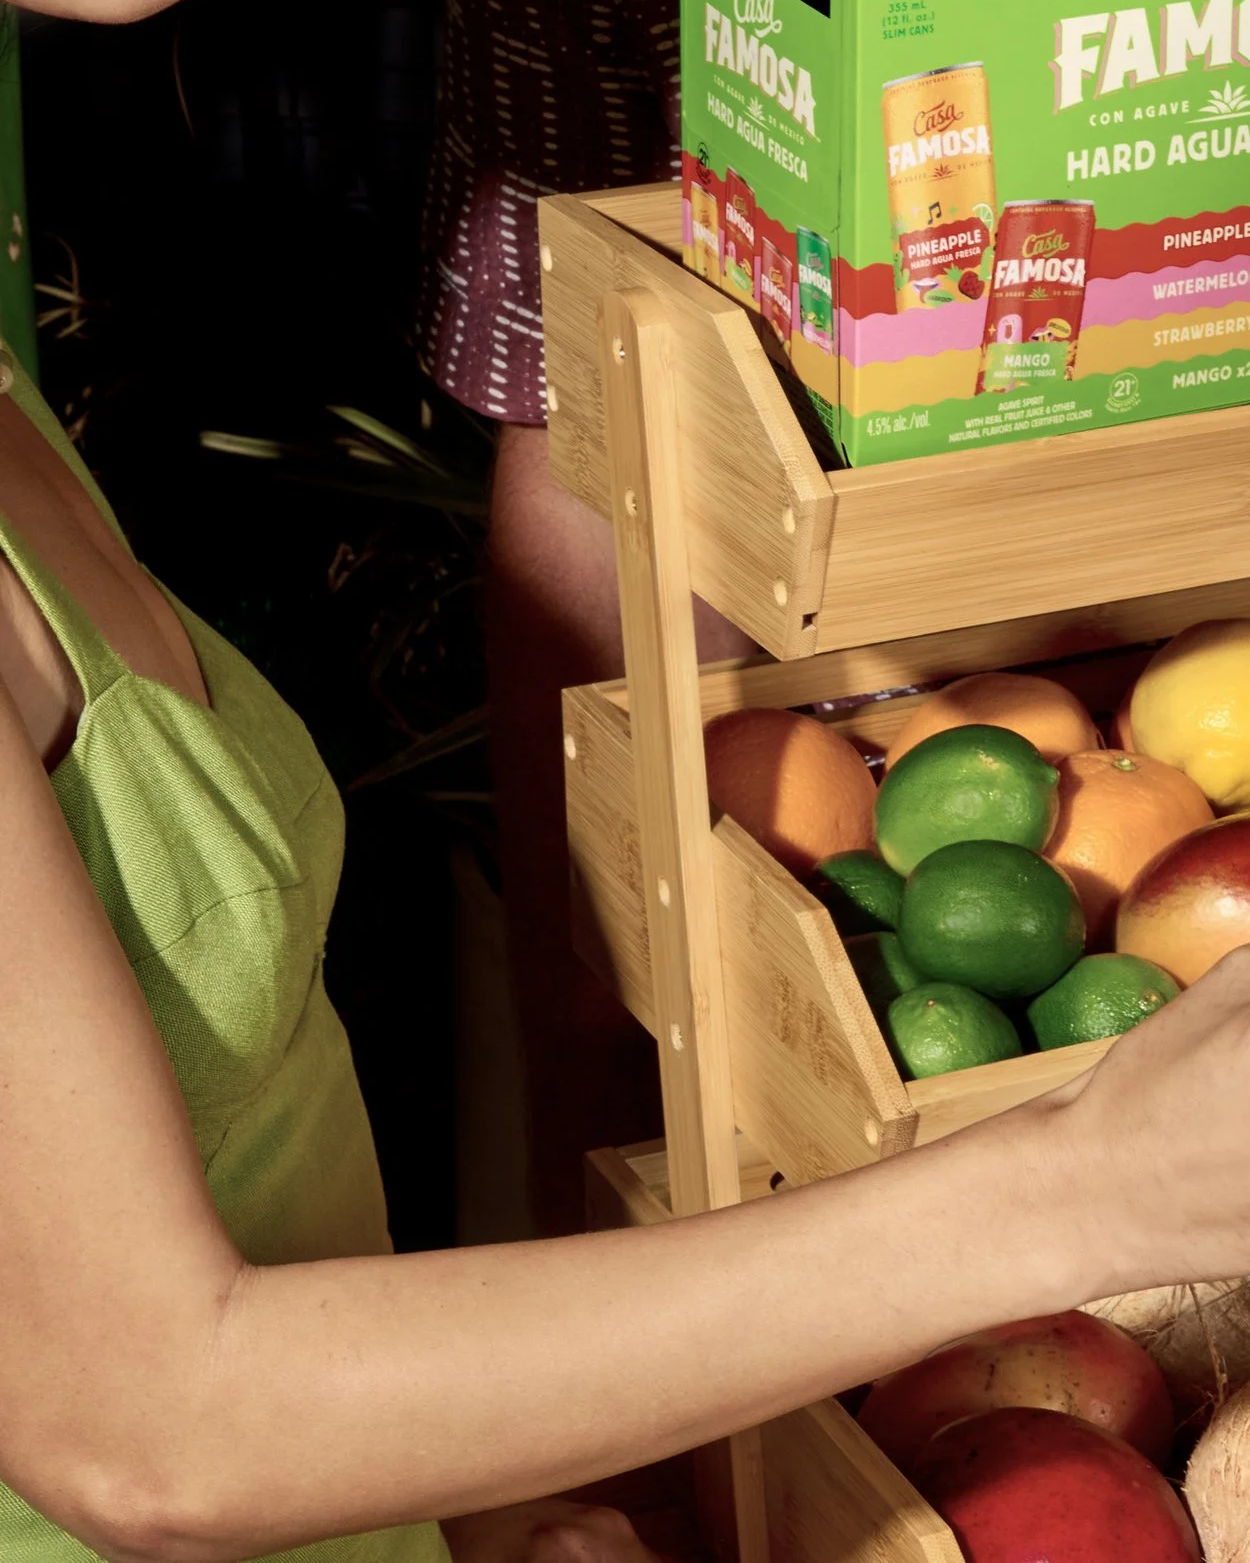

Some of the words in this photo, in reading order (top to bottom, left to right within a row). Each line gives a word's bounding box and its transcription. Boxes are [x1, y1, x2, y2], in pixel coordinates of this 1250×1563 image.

[888, 1, 908, 13] 355
[911, 0, 926, 10] mL
[883, 28, 906, 39] SLIM
[909, 24, 934, 36] CANS
[704, 1, 816, 136] FAMOSA
[914, 100, 964, 137] Casa
[1089, 110, 1124, 127] CON
[1133, 100, 1190, 121] AGAVE
[707, 91, 734, 130] HARD
[736, 115, 765, 154] AGUA
[768, 138, 808, 182] FRESCA
[888, 124, 992, 178] FAMOSA
[1066, 140, 1156, 181] HARD
[726, 201, 755, 245] FAMOSA
[907, 229, 982, 259] PINEAPPLE
[932, 254, 954, 266] AGUA
[955, 246, 981, 261] FRESCA
[1022, 229, 1070, 258] Casa
[799, 264, 833, 299] FAMOSA
[993, 258, 1087, 289] FAMOSA
[761, 274, 792, 318] FAMOSA
[1003, 353, 1051, 368] MANGO
[1172, 365, 1232, 389] MANGO
[866, 414, 892, 437] 4.5%
[892, 409, 930, 433] alc./vol.
